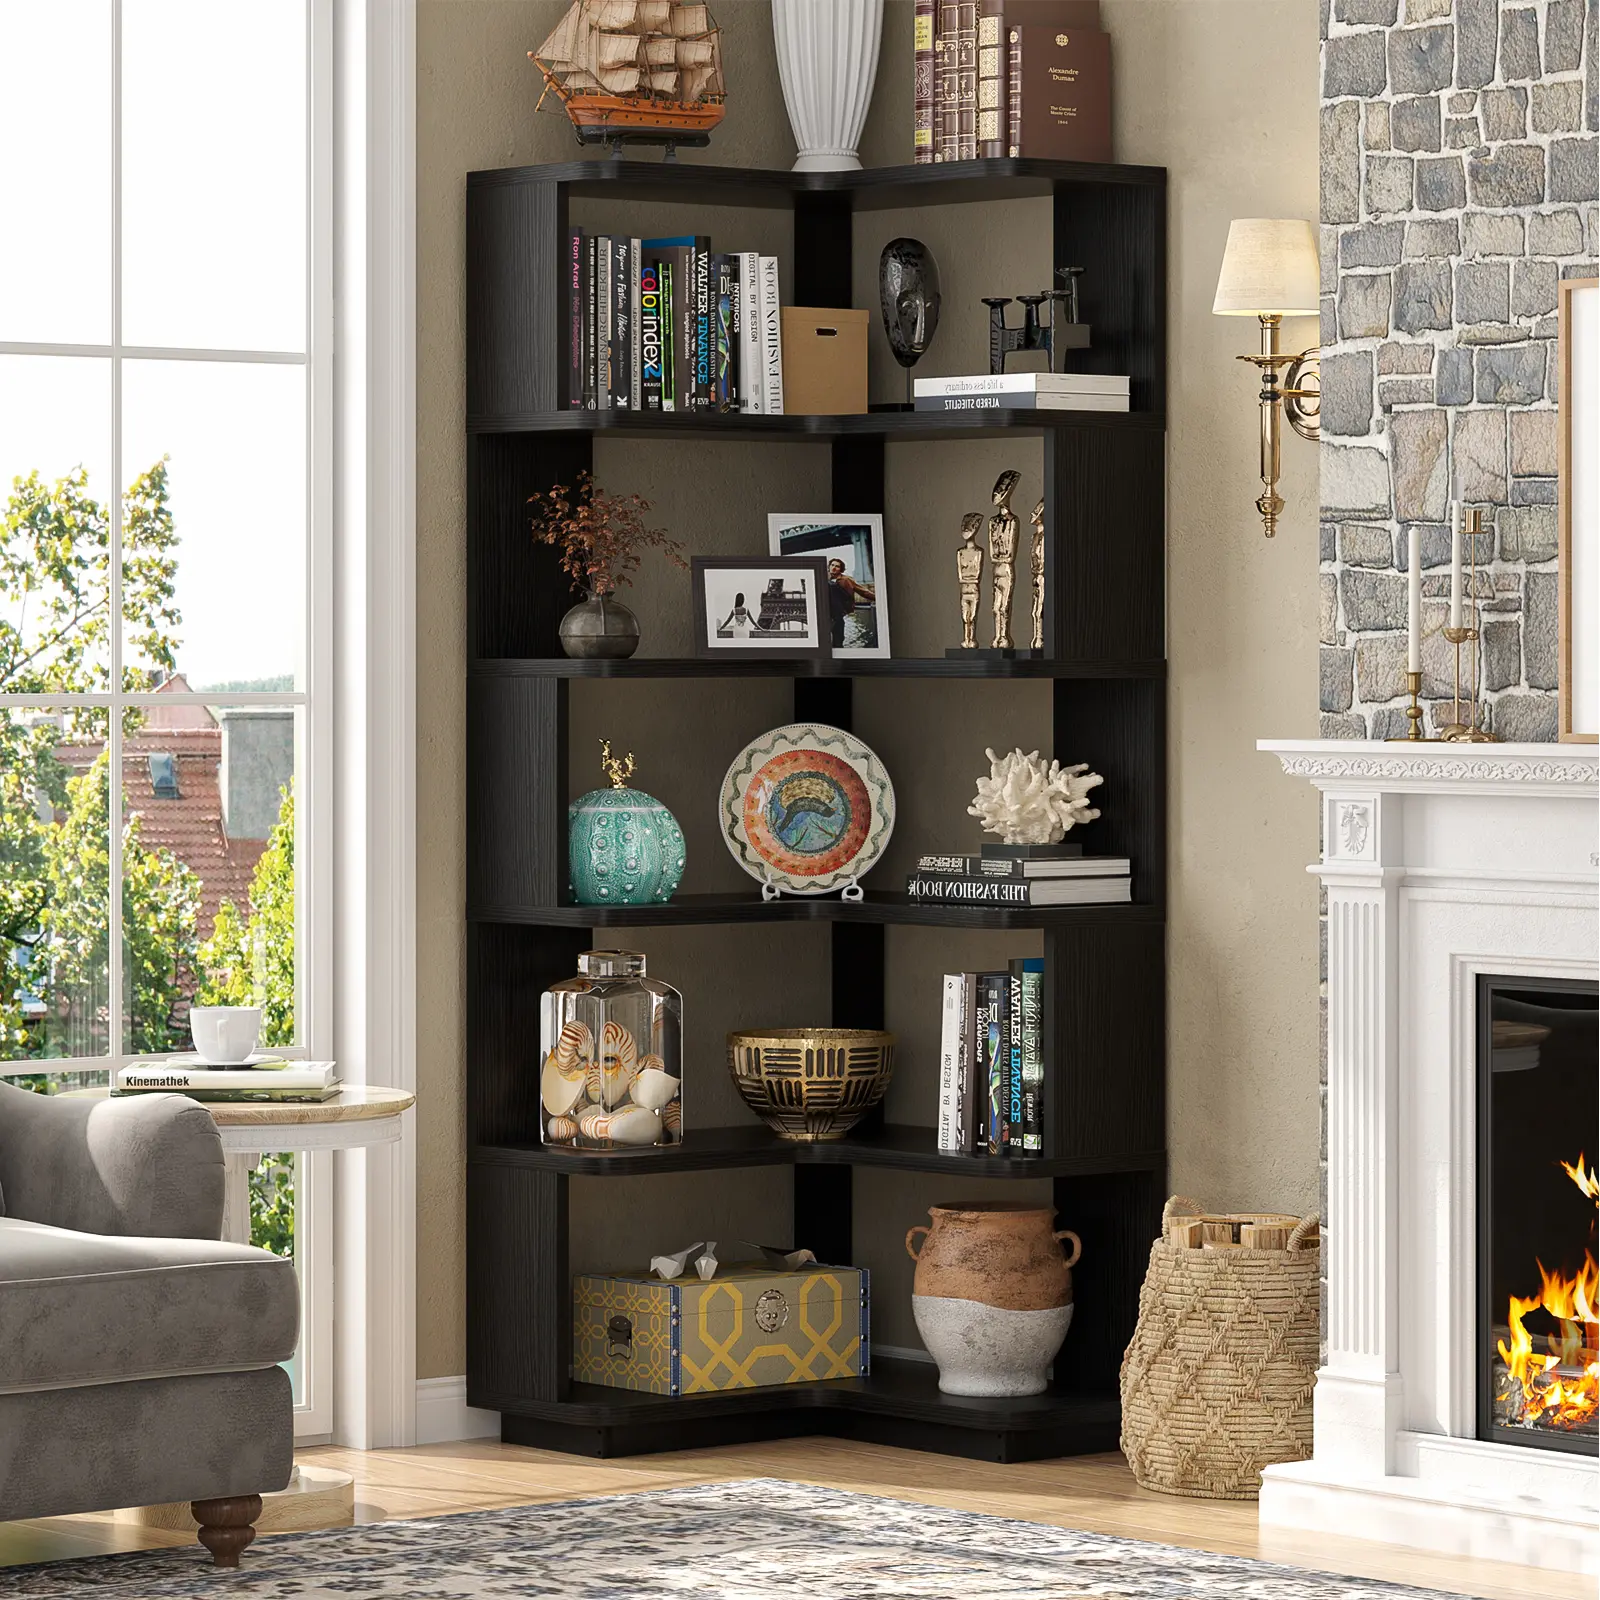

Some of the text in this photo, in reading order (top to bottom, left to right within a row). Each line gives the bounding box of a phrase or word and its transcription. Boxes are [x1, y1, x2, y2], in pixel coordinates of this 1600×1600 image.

[1048, 66, 1079, 75] Alexandre
[1052, 74, 1075, 82] Dumas
[572, 236, 580, 260] Ron
[572, 262, 580, 289] Arad
[748, 253, 757, 289] DIGITAL
[750, 294, 757, 305] BY
[599, 248, 607, 387] INNENARCHITEKTUR
[697, 251, 708, 385] WALTER FINANCE
[750, 310, 758, 343] DESIGN
[764, 260, 781, 413] THE FASHION BOOK
[126, 1075, 190, 1087] Kinemathek
